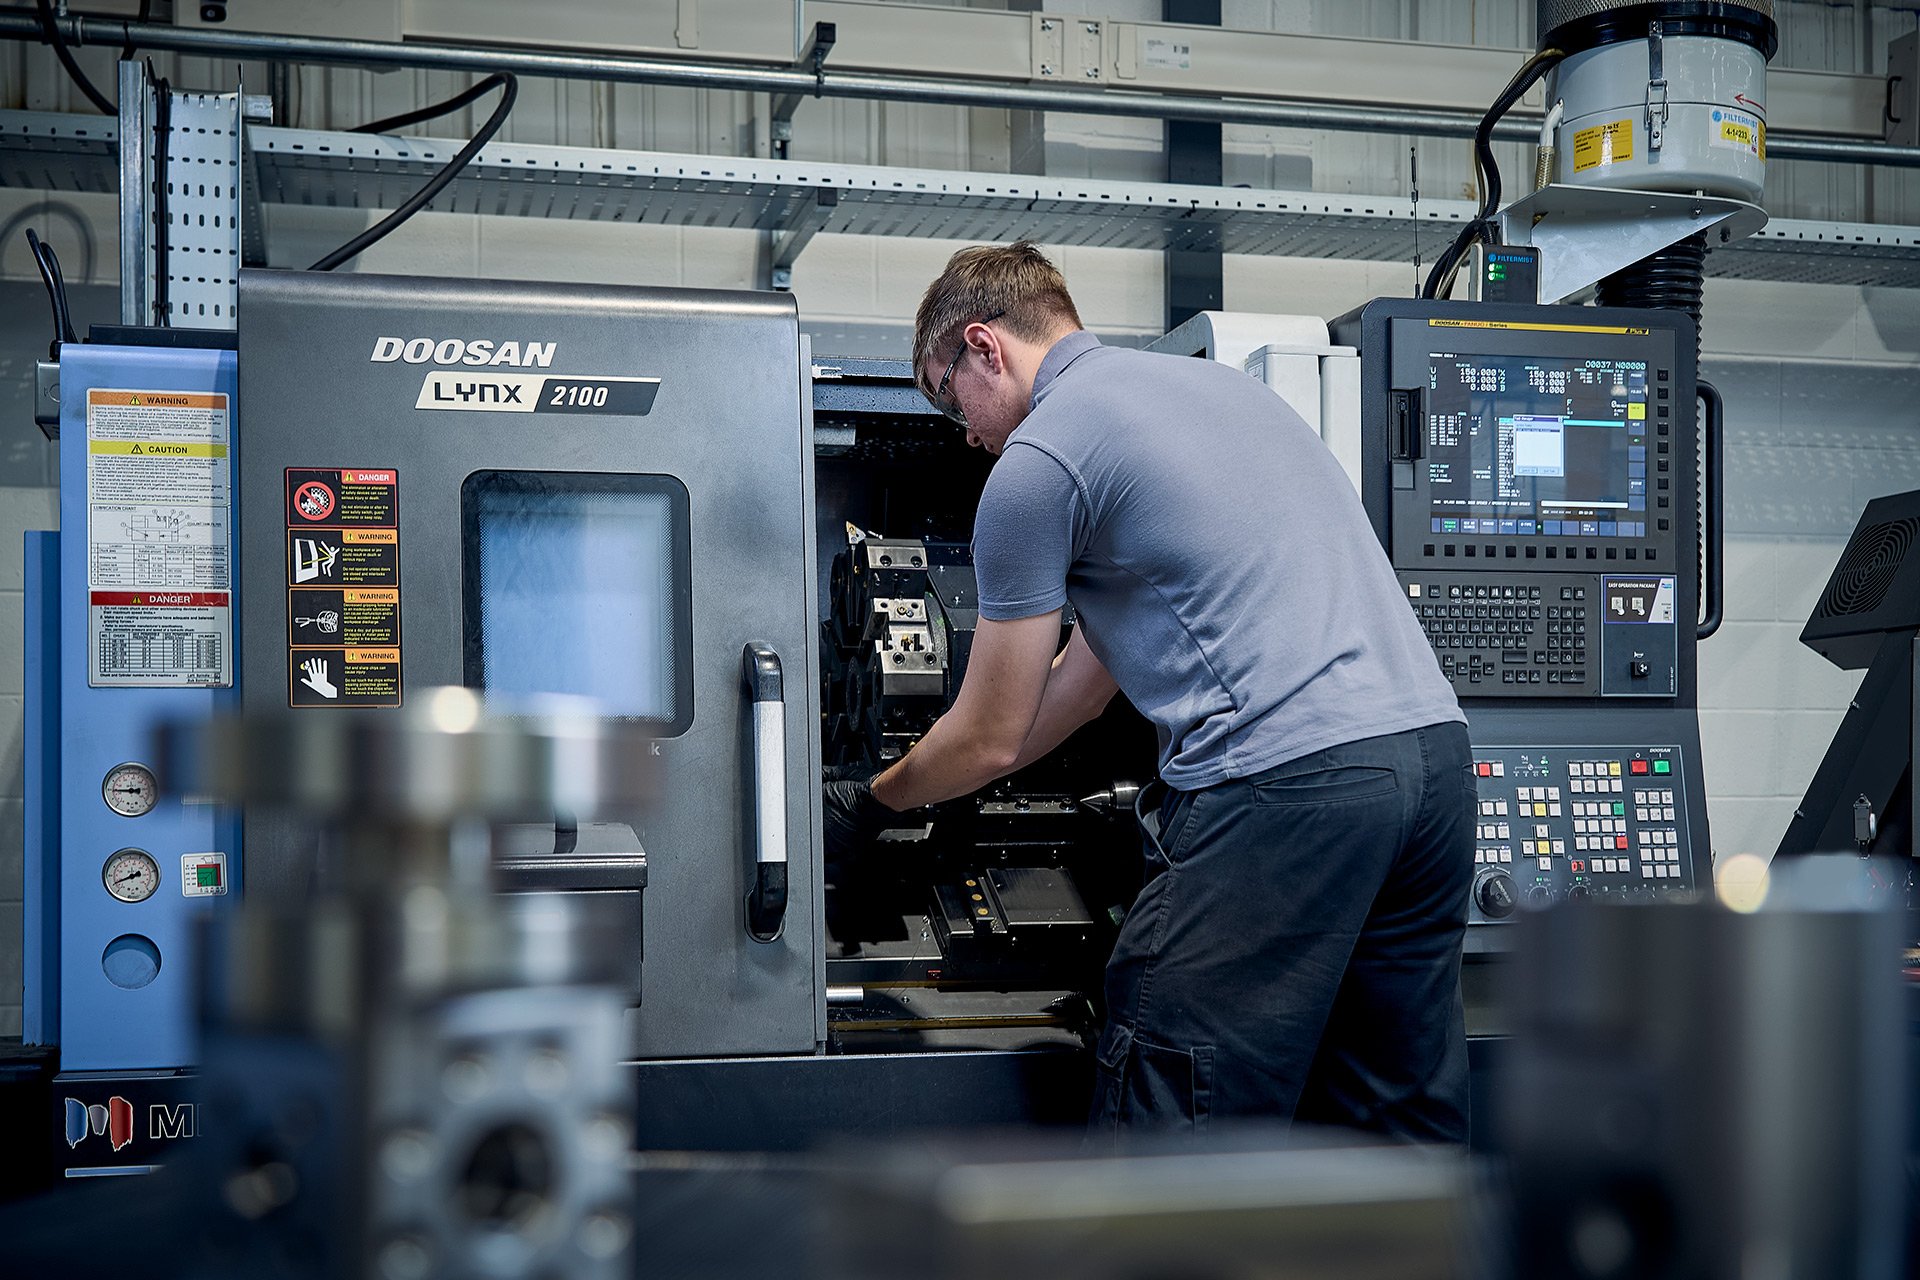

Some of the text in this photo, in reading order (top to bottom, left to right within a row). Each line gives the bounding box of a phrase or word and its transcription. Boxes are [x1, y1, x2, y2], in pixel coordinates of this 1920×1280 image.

[1724, 113, 1757, 128] FILTERMIST
[1497, 255, 1533, 263] FILTERMIST
[370, 337, 557, 367] DOOSAN
[1615, 362, 1646, 370] N00000
[1460, 368, 1497, 376] 150.000
[1529, 370, 1565, 378] 150.000
[1460, 376, 1497, 384] 120.000
[1529, 378, 1565, 386] 120.000
[434, 381, 609, 407] LYNX 2100
[1539, 386, 1565, 394] 0.000
[147, 397, 189, 405] WARNING
[149, 446, 188, 454] CAUTION
[149, 595, 191, 603] DANGER
